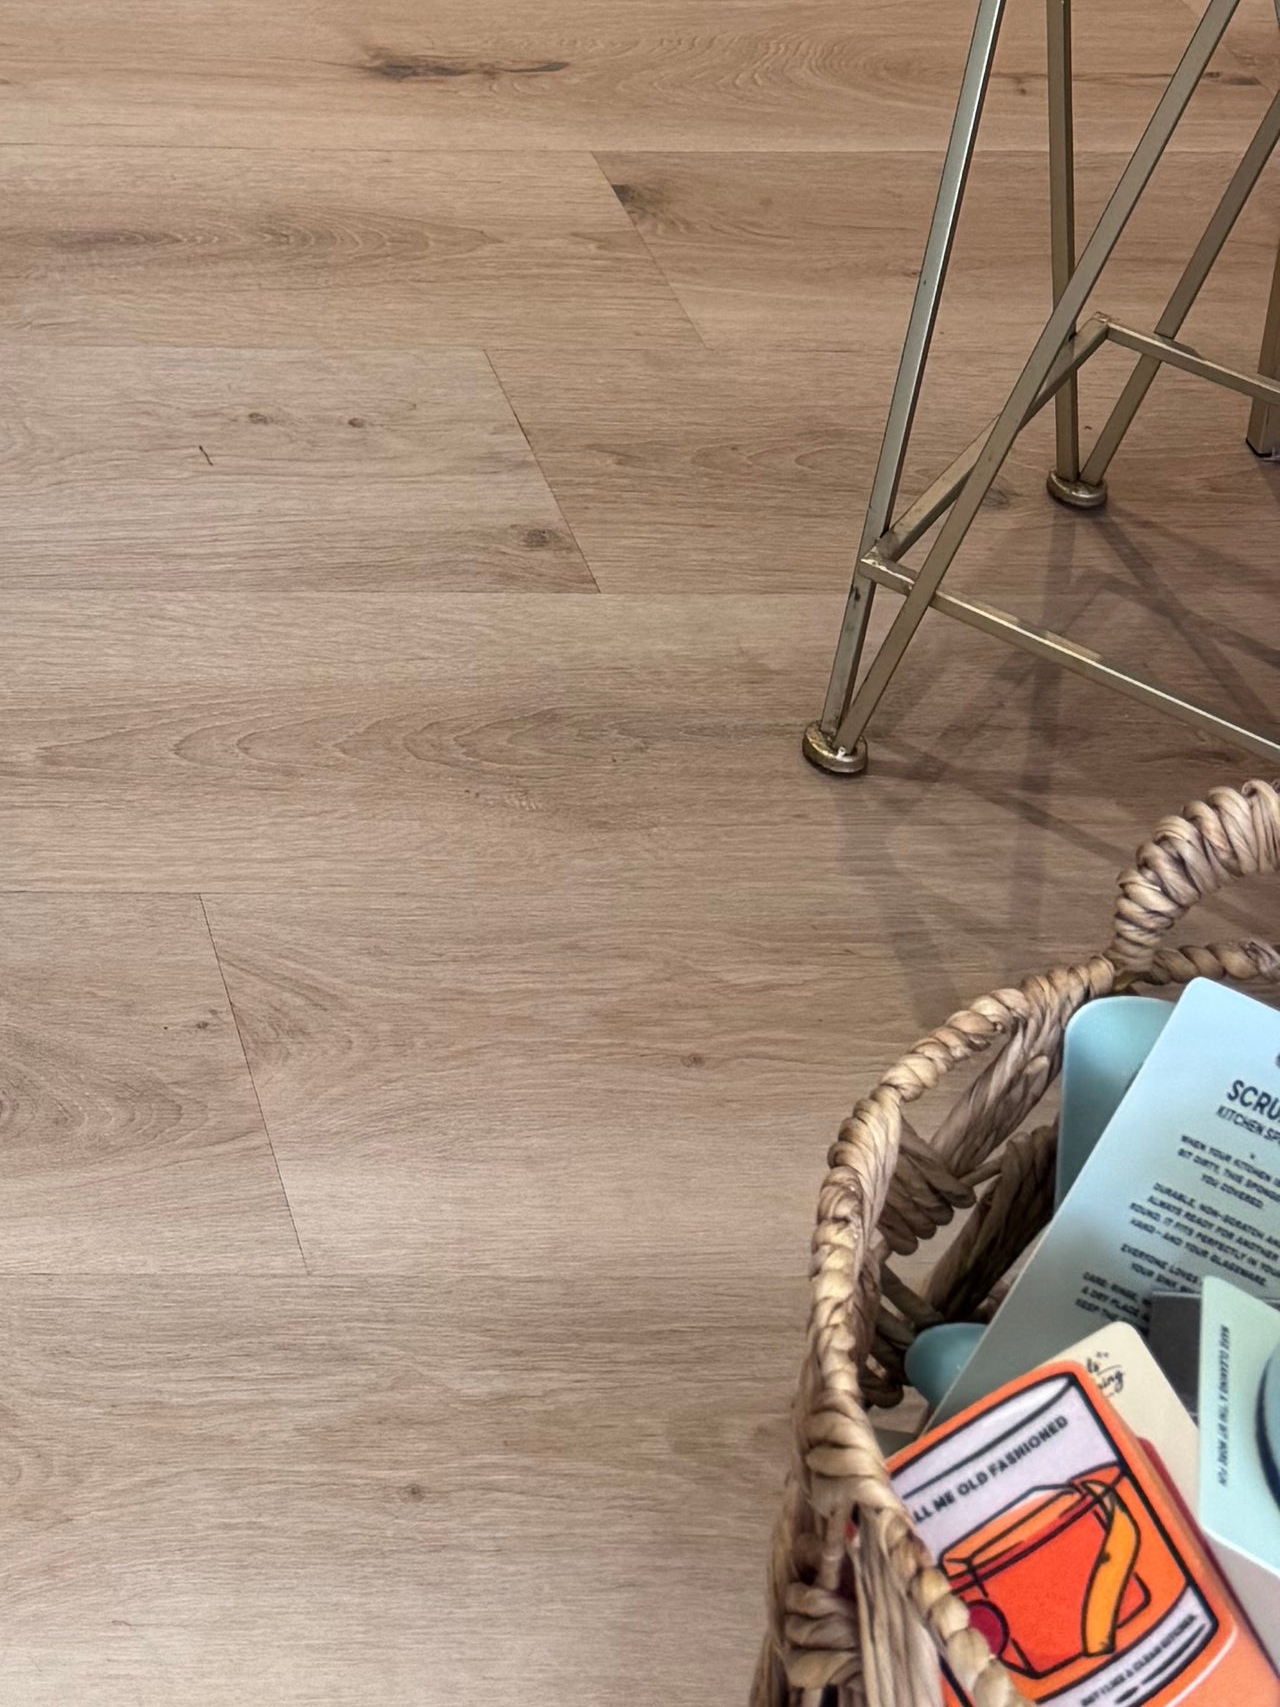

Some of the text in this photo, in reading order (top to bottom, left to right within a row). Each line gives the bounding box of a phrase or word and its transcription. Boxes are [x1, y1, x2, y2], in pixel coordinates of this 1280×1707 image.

[1226, 1079, 1280, 1121] SCRU
[1216, 1105, 1265, 1136] KITCHEN
[1202, 1174, 1219, 1188] YOU
[932, 1493, 956, 1512] ME
[957, 1472, 989, 1497] OLD
[987, 1415, 1069, 1477] FASHIONED
